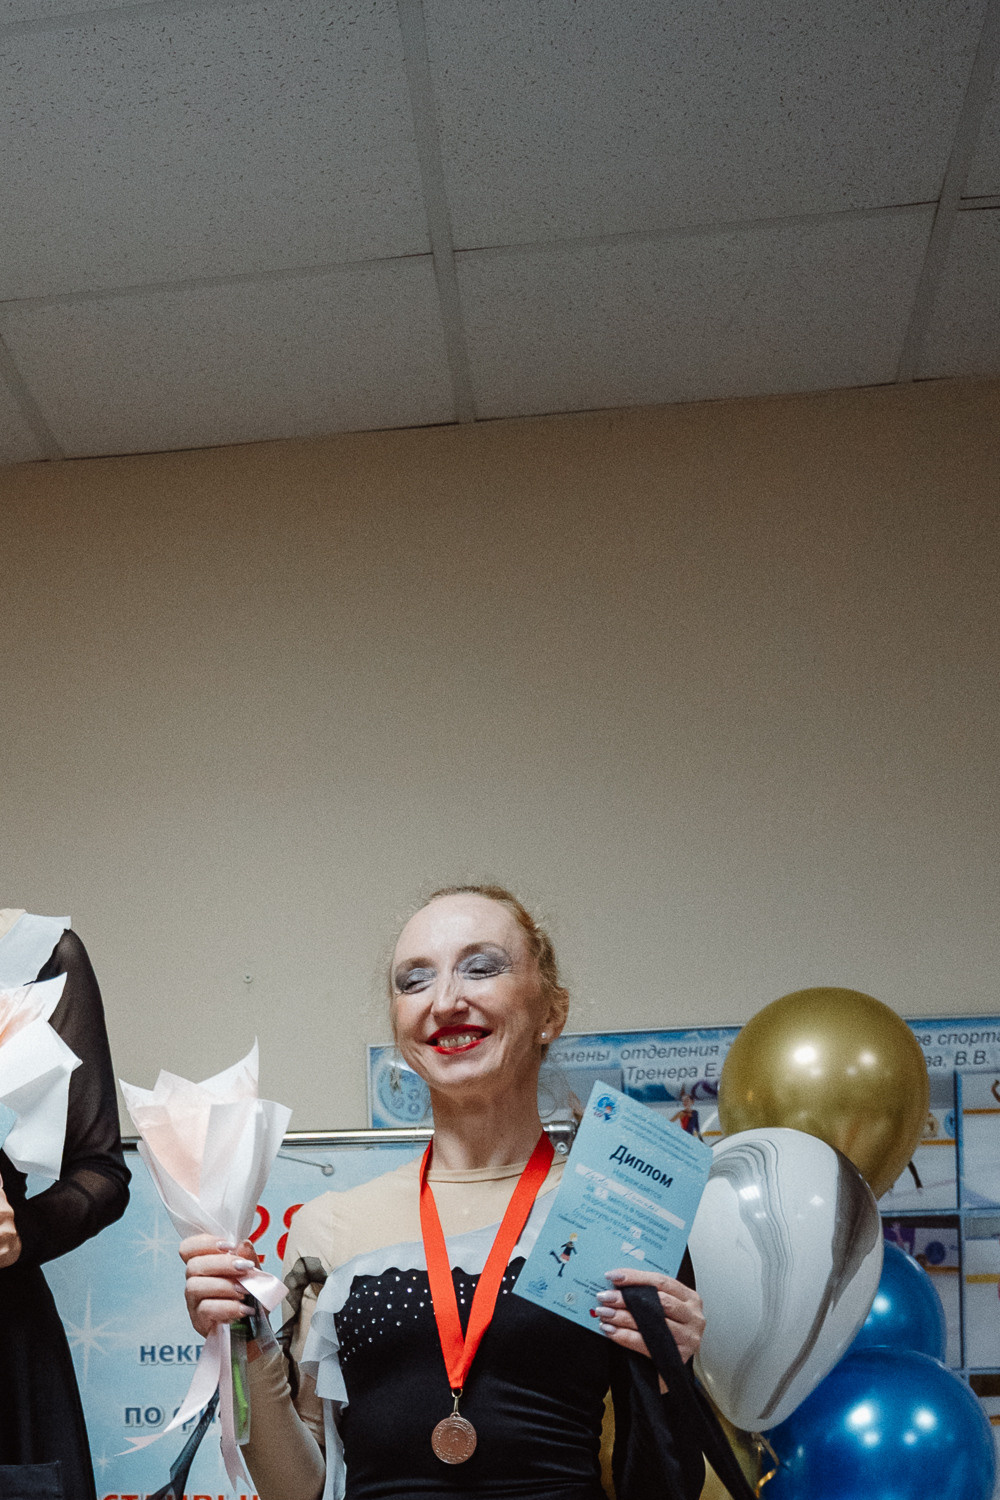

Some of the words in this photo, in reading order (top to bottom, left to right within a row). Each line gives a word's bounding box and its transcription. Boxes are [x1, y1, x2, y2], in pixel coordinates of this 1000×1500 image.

[620, 1044, 719, 1061] отделения
[627, 1065, 698, 1084] Тренера
[609, 1144, 674, 1188] Диплом
[125, 1406, 161, 1424] по
